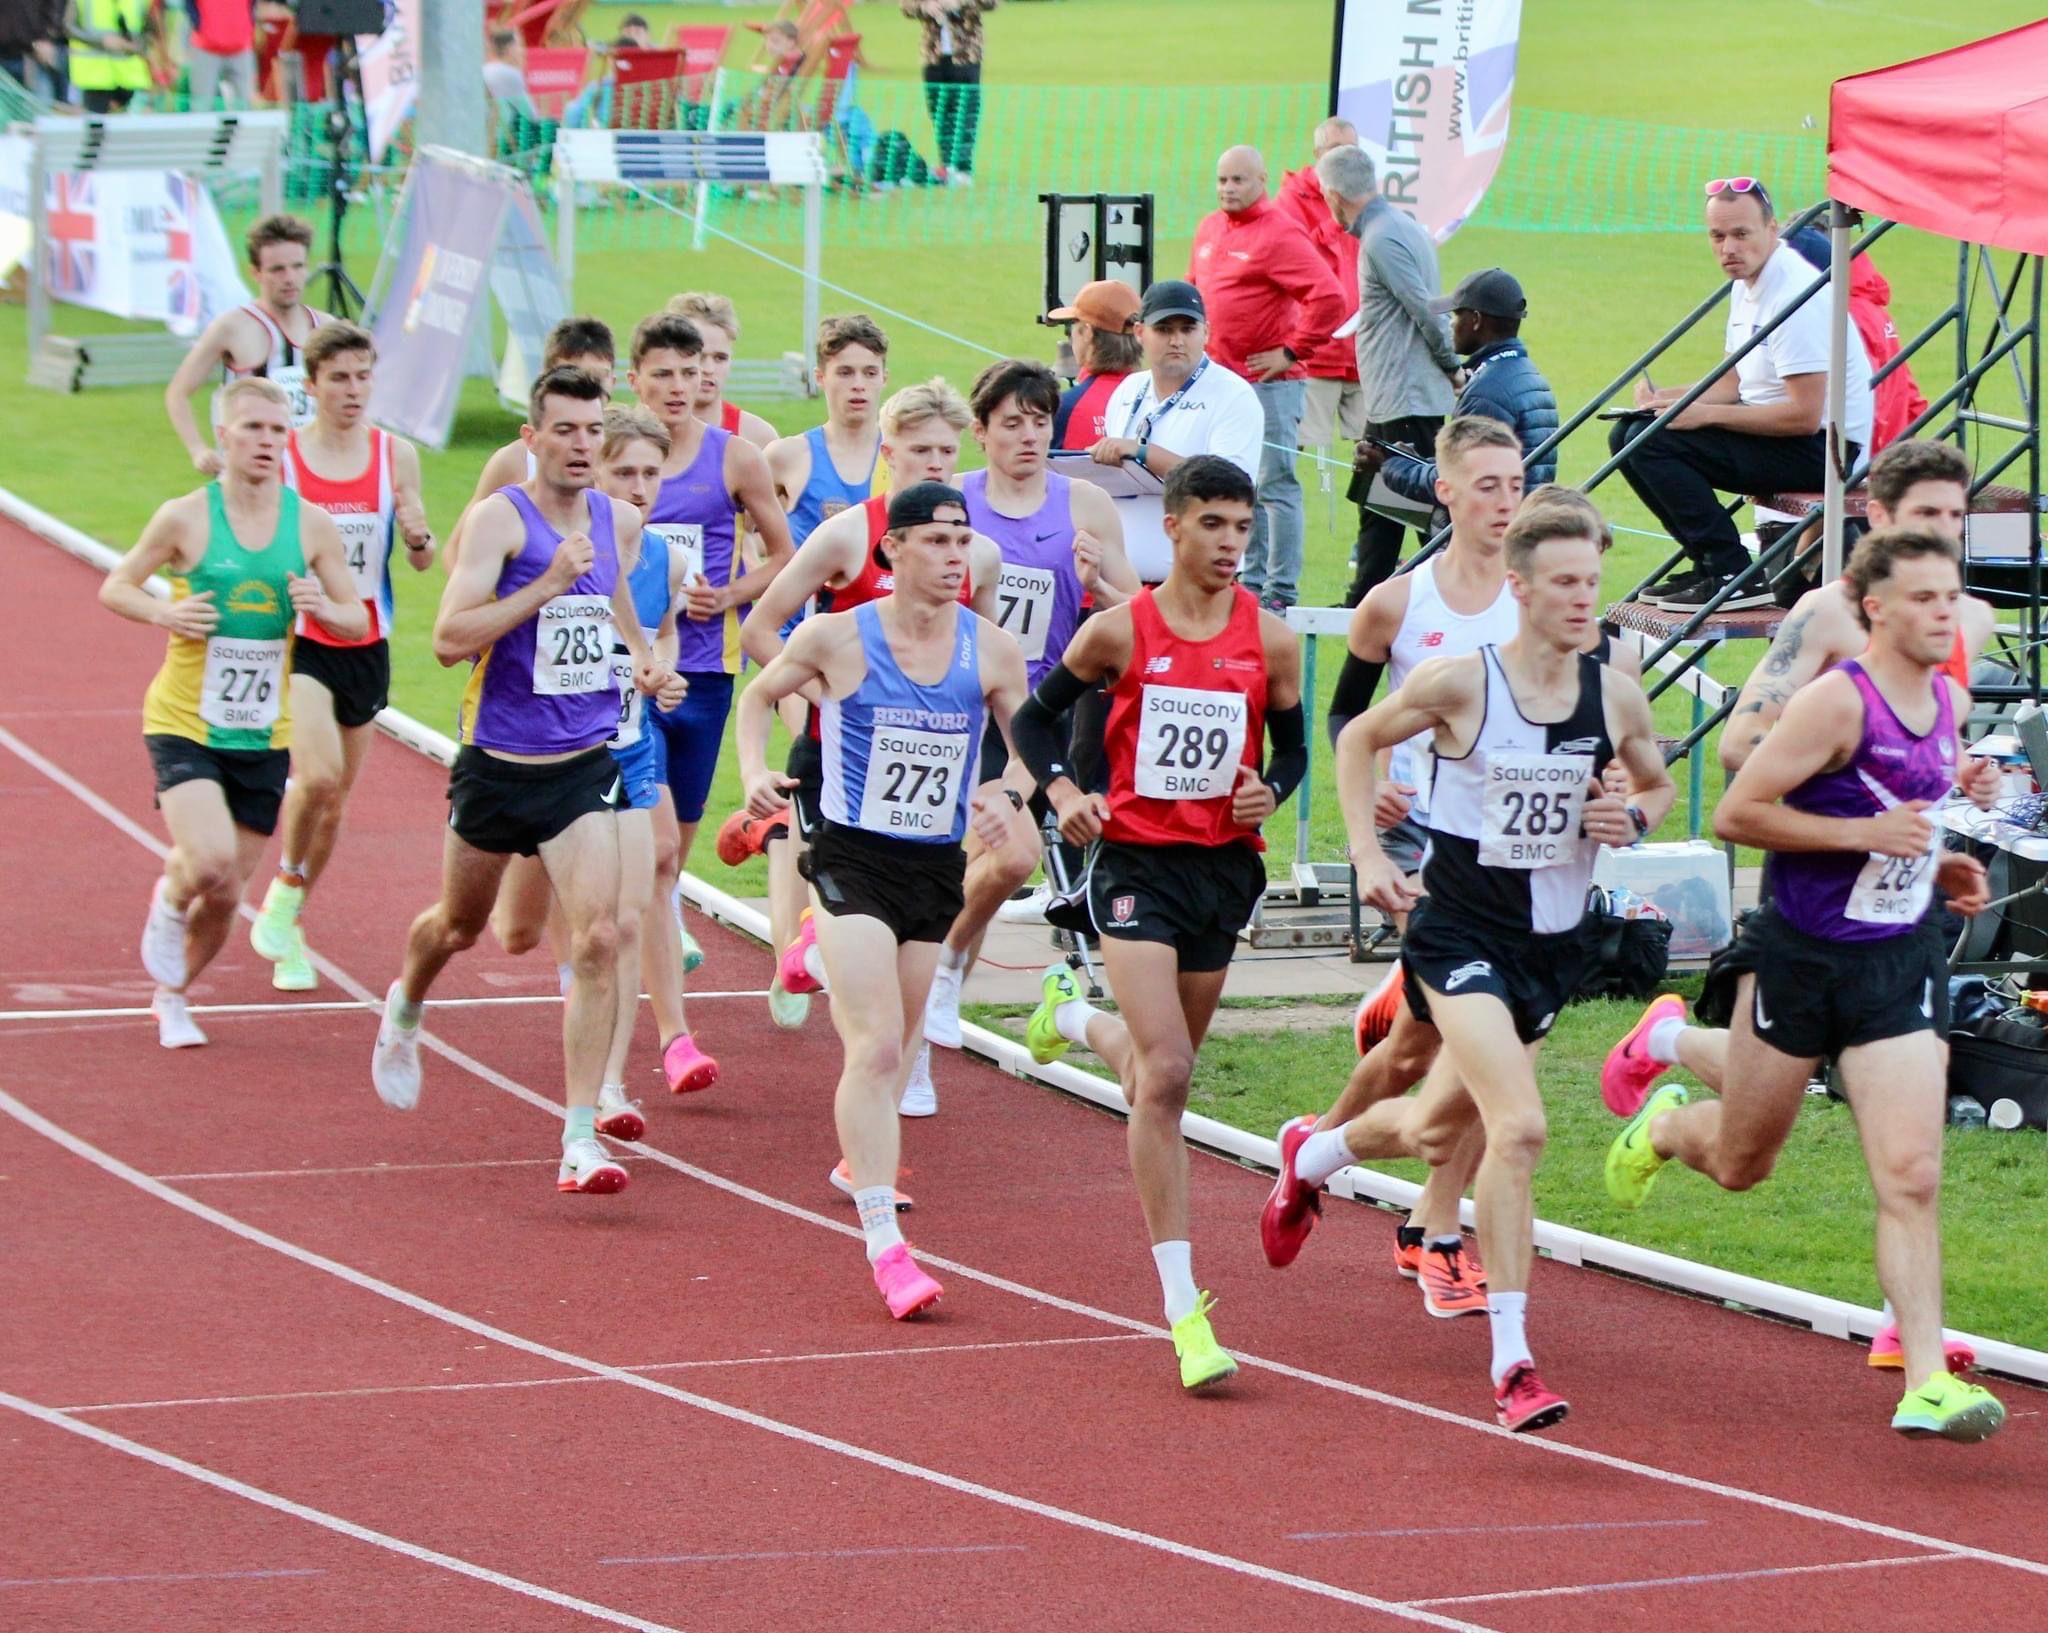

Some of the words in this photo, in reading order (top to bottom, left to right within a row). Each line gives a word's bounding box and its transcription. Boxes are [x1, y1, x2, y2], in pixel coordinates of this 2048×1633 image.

[1383, 36, 1438, 219] RITISH
[336, 522, 375, 536] cony
[998, 595, 1034, 634] 71
[212, 646, 280, 662] saucony
[552, 625, 604, 666] 283
[219, 668, 271, 702] 276
[560, 671, 594, 687] BMC
[224, 709, 261, 722] BMC
[872, 706, 969, 729] BEDFORD
[1149, 698, 1242, 722] saucony
[879, 738, 964, 760] saucony
[1155, 723, 1229, 770] 289
[881, 762, 949, 807] 273
[1164, 776, 1211, 793] BMC
[1493, 767, 1588, 785] saucony
[889, 810, 934, 829] BMC
[1501, 791, 1571, 836] 285
[1511, 844, 1557, 860] BMC
[1117, 899, 1128, 915] H
